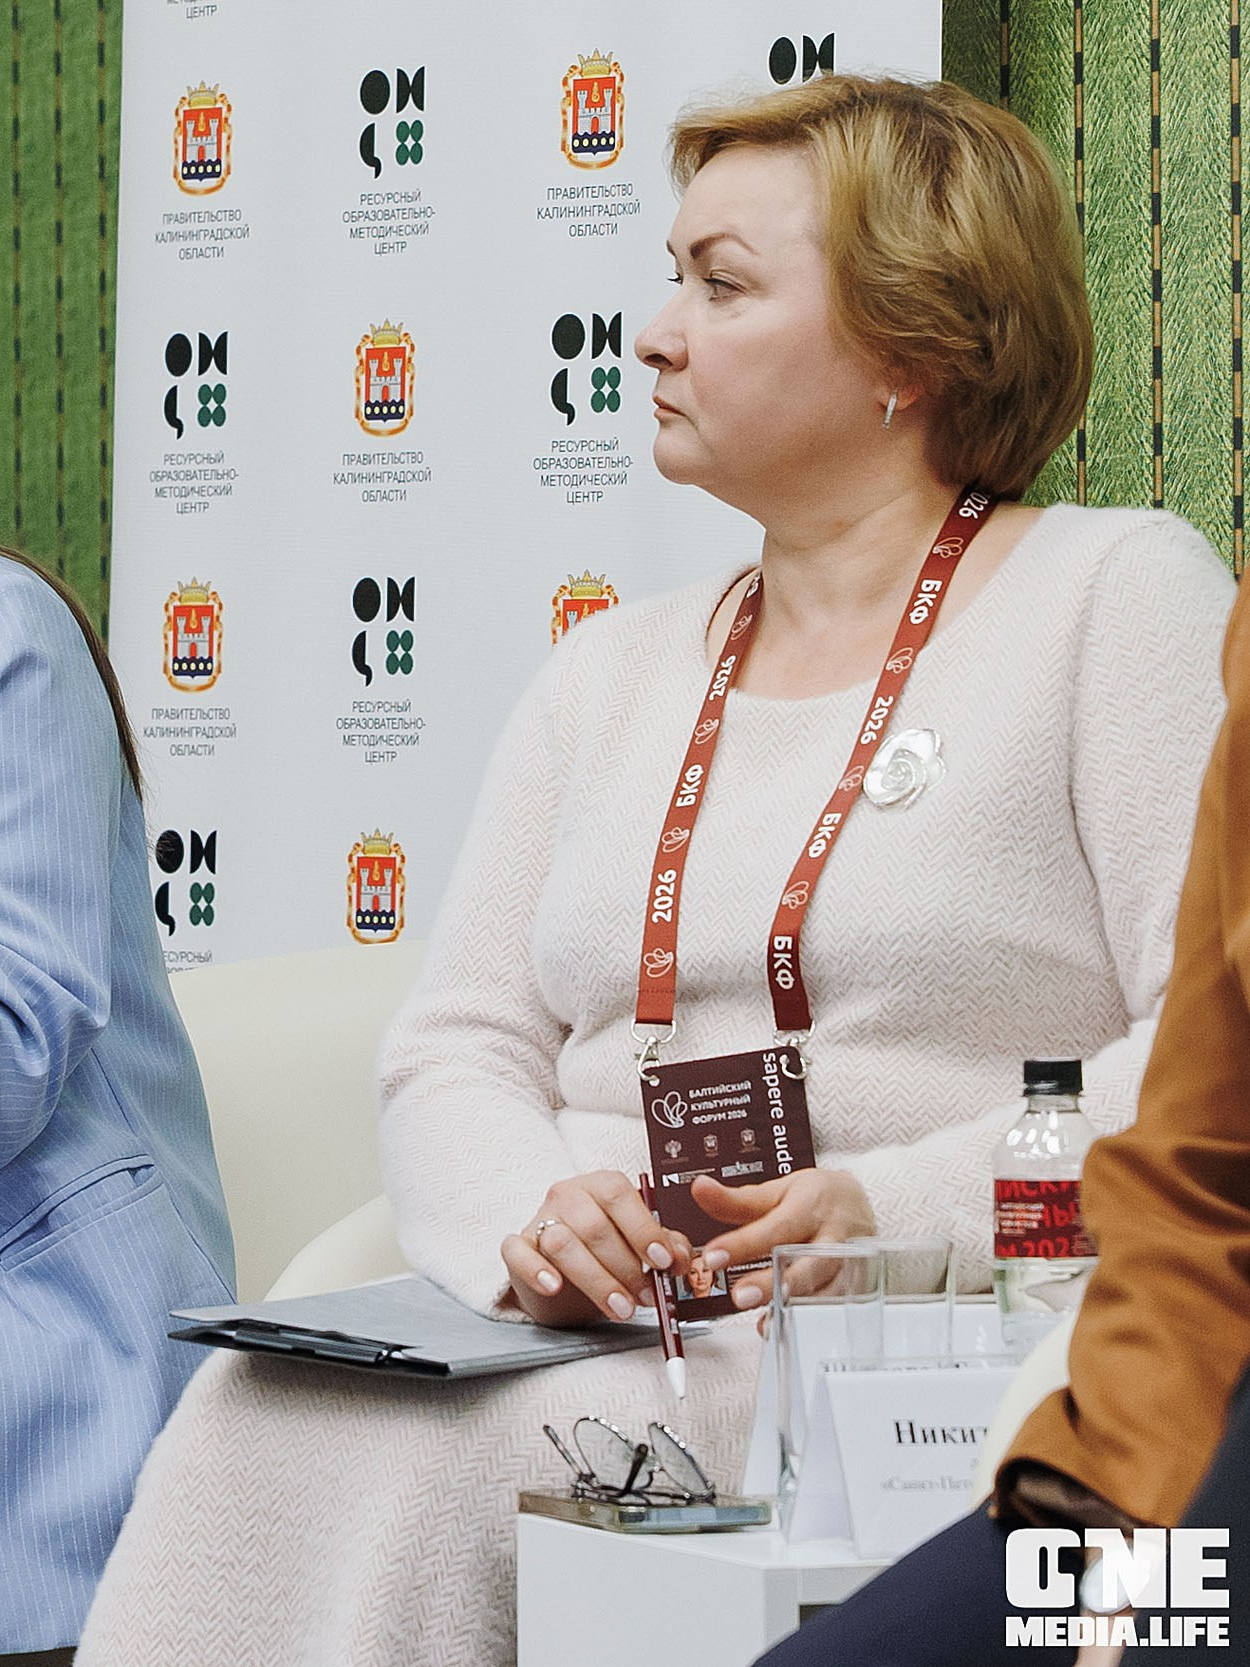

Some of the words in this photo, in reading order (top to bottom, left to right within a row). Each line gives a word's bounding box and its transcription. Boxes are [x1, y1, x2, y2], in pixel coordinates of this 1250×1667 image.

[186, 5, 217, 20] ЦЕНТР
[360, 188, 421, 205] РЕСУРСНЫЙ
[547, 183, 634, 200] ПРАВИТЕЛЬСТВО
[162, 209, 242, 225] ПРАВИТЕЛЬСТВО
[342, 207, 436, 223] ОБРАЗОВАТЕЛЬНО-
[537, 200, 641, 219] КАЛИНИНГРАДСКОЙ
[155, 226, 250, 243] КАЛИНИНГРАДСКОЙ
[349, 221, 430, 239] МЕТОДИЧЕСКИЙ
[569, 223, 618, 237] ОБЛАСТИ
[179, 246, 224, 260] ОБЛАСТИ
[374, 241, 407, 256] ЦЕНТР
[551, 437, 619, 453] РЕСУРСНЫЙ
[164, 450, 224, 465] РЕСУРСНЫЙ
[342, 451, 423, 465] ПРАВИТЕЛЬСТВО
[533, 456, 634, 470] ОБРАЗОВАТЕЛЬНО-
[150, 468, 239, 482] ОБРАЗОВАТЕЛЬНО-
[333, 467, 431, 484] КАЛИНИНГРАДСКОЙ
[540, 471, 627, 487] МЕТОДИЧЕСКИЙ
[154, 483, 232, 498] МЕТОДИЧЕСКИЙ
[362, 489, 407, 502] ОБЛАСТИ
[566, 491, 604, 505] ЦЕНТР
[176, 502, 209, 515] ЦЕНТР
[959, 491, 989, 519] 026
[909, 579, 942, 624] БКФ
[709, 655, 736, 701] 2026
[151, 708, 230, 720] ПРАВИТЕЛЬСТВО
[352, 699, 411, 713] РЕСУРСНЫЙ
[336, 717, 426, 731] ОБРАЗОВАТЕЛЬНО-
[860, 696, 893, 745] 2026
[143, 723, 236, 739] КАЛИНИНГРАДСКОЙ
[343, 731, 419, 747] МЕТОДИЧЕСКИЙ
[170, 744, 214, 756] ОБЛАСТИ
[365, 751, 398, 764] ЦЕНТР
[676, 764, 704, 808] БКФ
[808, 812, 842, 858] БКФ
[652, 869, 677, 923] 2026
[774, 936, 795, 990] БКФ
[689, 1080, 751, 1099] БАЛТИЙСКИЙ
[691, 1094, 751, 1111] КУЛЬТУРНЫЙ
[692, 1112, 726, 1125] ФОРУМ
[728, 1108, 747, 1120] 2026
[762, 1052, 784, 1119] sapere
[773, 1125, 794, 1175] aude
[892, 1418, 988, 1445] Никит
